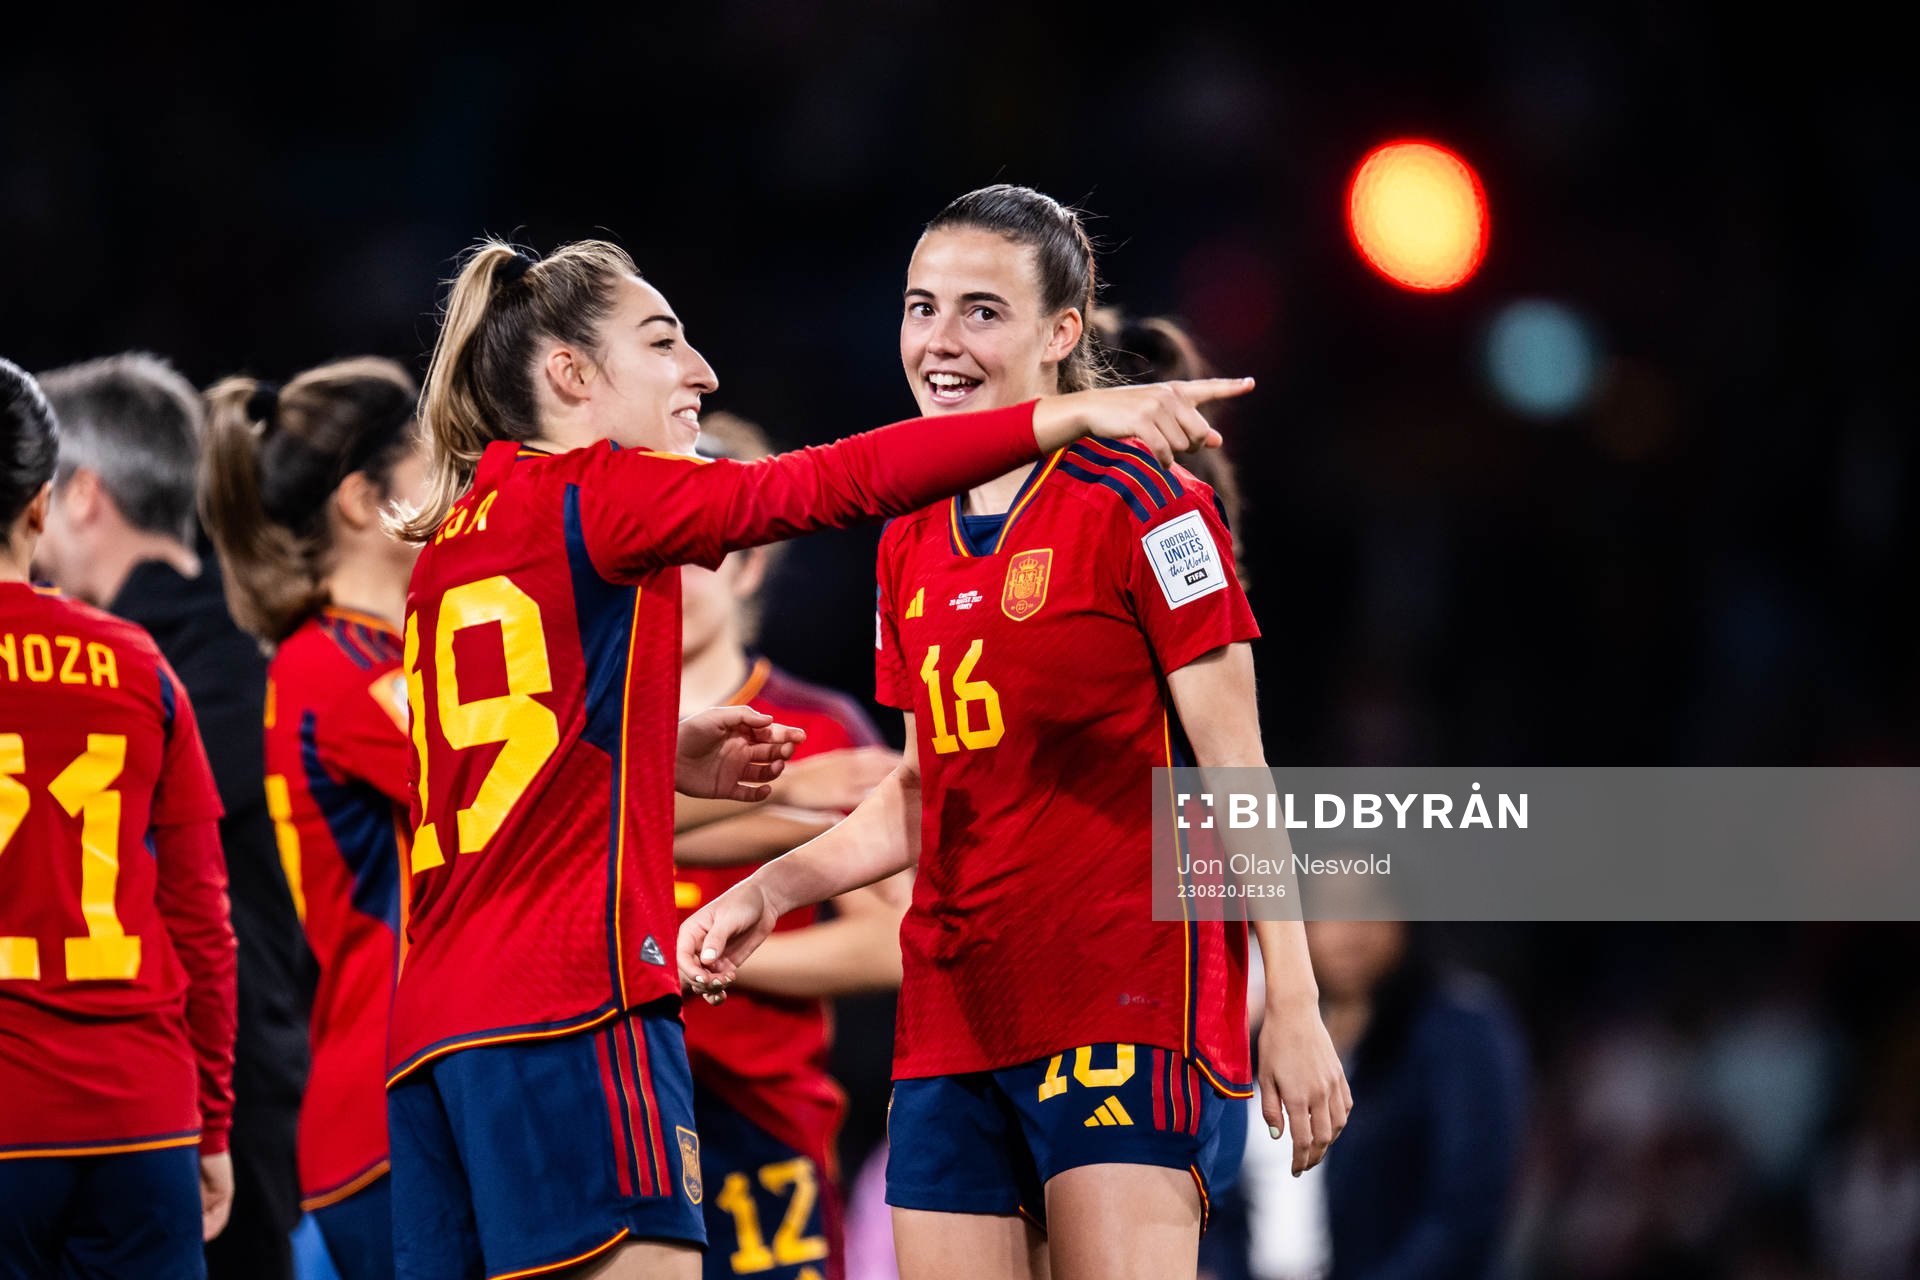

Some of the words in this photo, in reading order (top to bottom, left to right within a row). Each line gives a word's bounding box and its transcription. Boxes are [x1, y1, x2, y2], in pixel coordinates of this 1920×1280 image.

[1159, 528, 1198, 551] FOOTBALL
[1164, 537, 1204, 564] UNITES
[1169, 563, 1185, 578] the
[1184, 550, 1211, 571] World
[1186, 570, 1207, 584] FIFA
[920, 639, 1005, 755] 16
[403, 575, 560, 876] 19
[716, 1156, 829, 1275] 12
